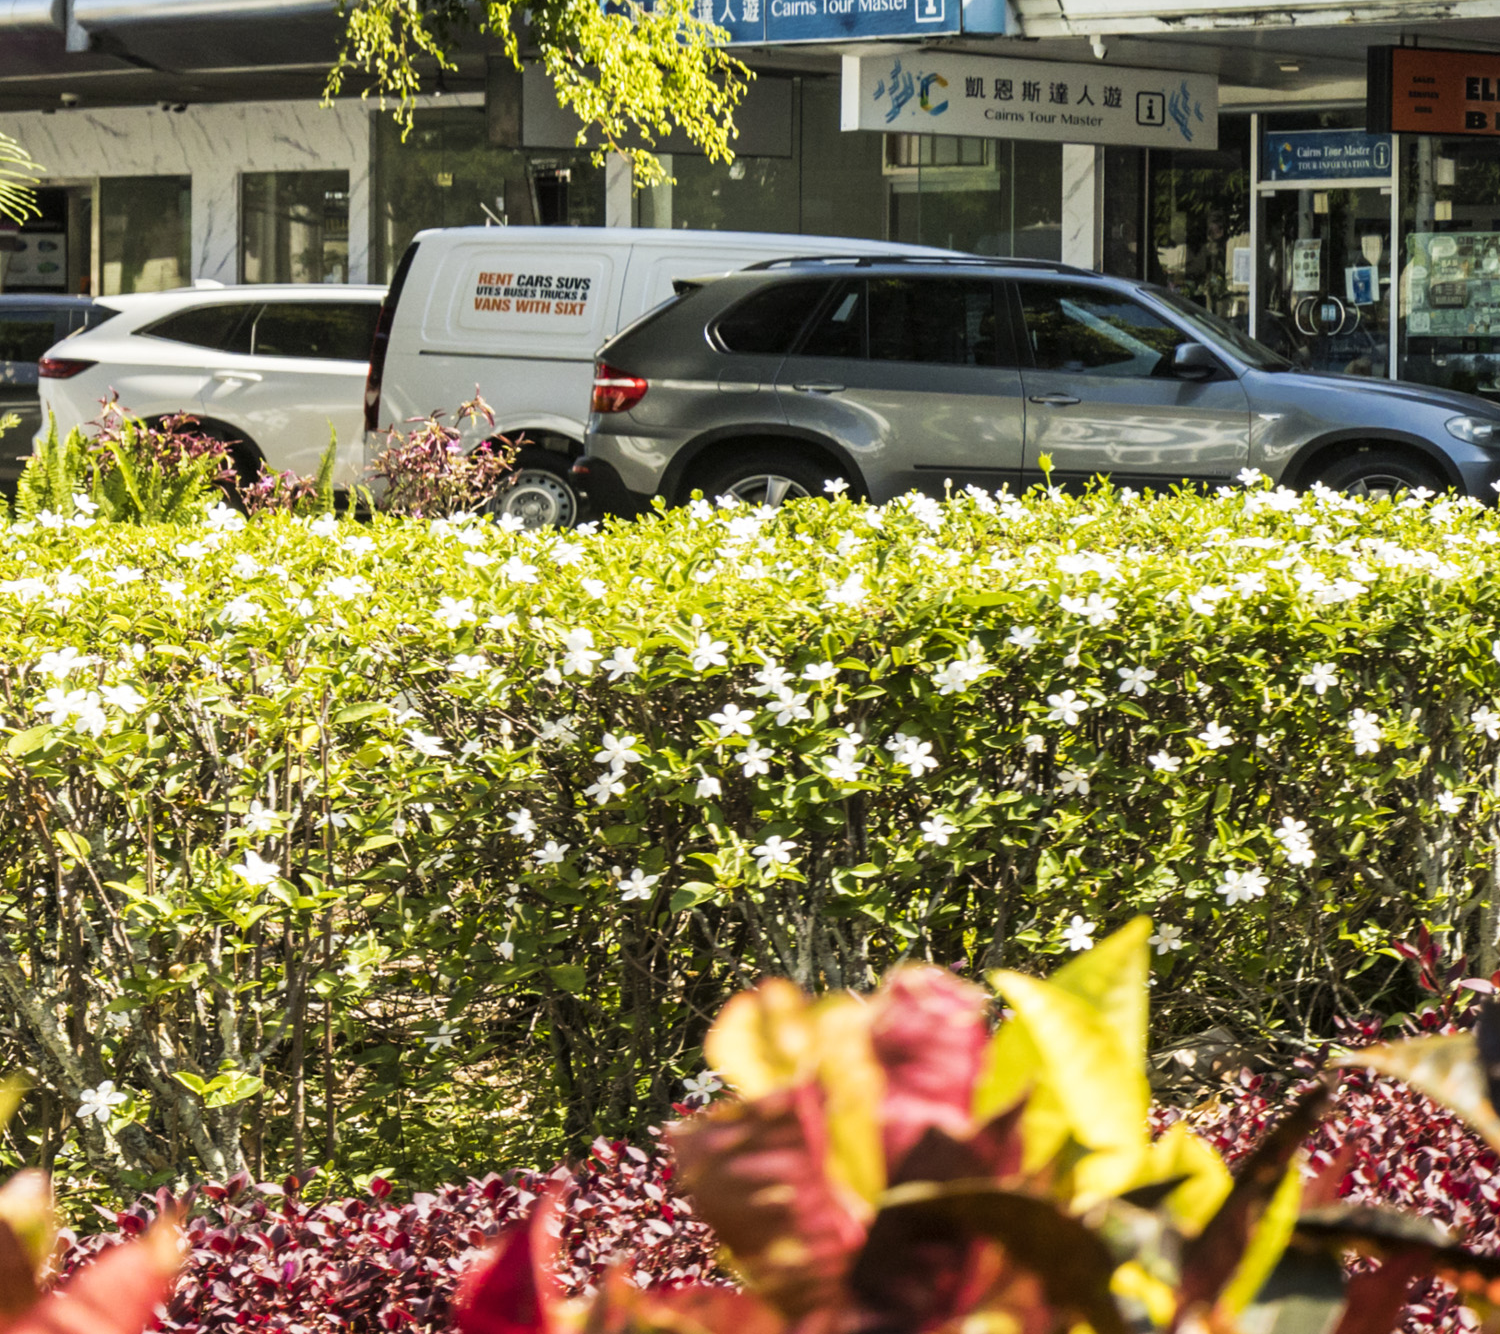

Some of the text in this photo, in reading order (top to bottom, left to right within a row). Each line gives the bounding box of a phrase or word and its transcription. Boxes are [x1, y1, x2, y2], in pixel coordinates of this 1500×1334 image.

[965, 76, 1123, 109] 凱恩斯達人遊
[984, 108, 1104, 128] Cairns Tour Master
[1297, 144, 1370, 158] Cairns Tour Master
[1298, 159, 1370, 170] TOUR INFORMATION
[478, 272, 591, 291] RENT CARS SUVS
[476, 286, 501, 296] UTES
[503, 287, 537, 299] BUSES
[540, 289, 578, 301] TRUCKS
[474, 297, 586, 316] VANS WITH SIXT
